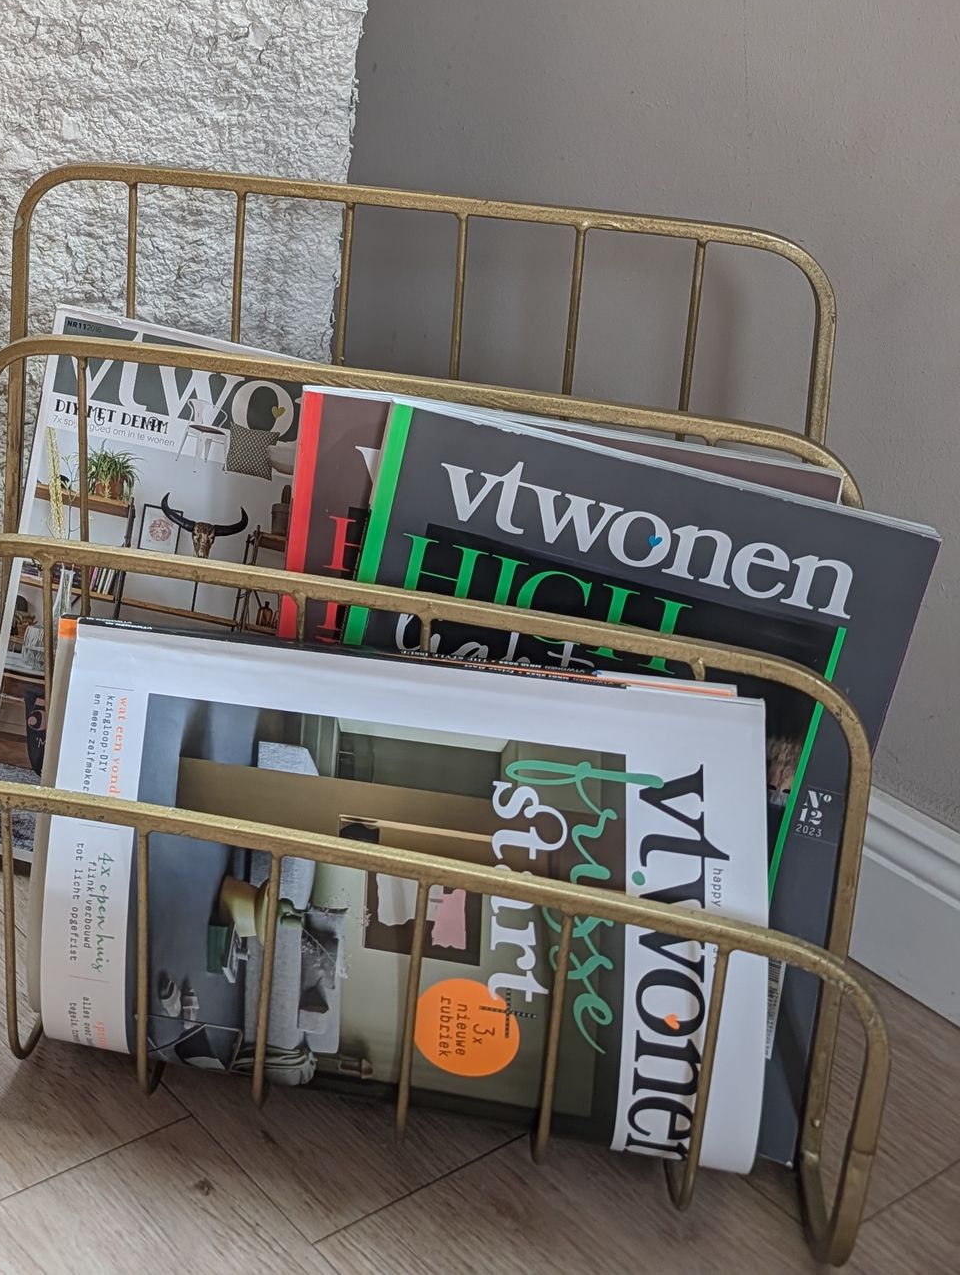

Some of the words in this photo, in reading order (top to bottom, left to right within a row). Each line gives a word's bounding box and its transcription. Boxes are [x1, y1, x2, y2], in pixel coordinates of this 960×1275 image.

[62, 331, 302, 439] vtwo
[146, 434, 175, 447] wonen
[441, 460, 855, 620] vtwonen
[93, 693, 101, 705] en
[118, 697, 127, 720] wat
[90, 710, 99, 734] meer
[98, 695, 115, 773] kringloop-DIY
[114, 726, 123, 751] een
[109, 758, 121, 798] vond
[795, 823, 823, 838] 2023
[799, 807, 823, 826] 12
[74, 842, 85, 861] tot
[98, 852, 115, 878] 4x
[72, 868, 84, 900] licht
[86, 860, 97, 893] flink
[711, 867, 724, 908] happy
[89, 883, 110, 930] open
[68, 906, 81, 962] opgefrist
[82, 899, 95, 949] verbouwd
[91, 933, 115, 973] huis
[438, 995, 454, 1057] rubriek
[454, 1003, 470, 1056] nieuwe
[472, 1023, 496, 1045] 3x
